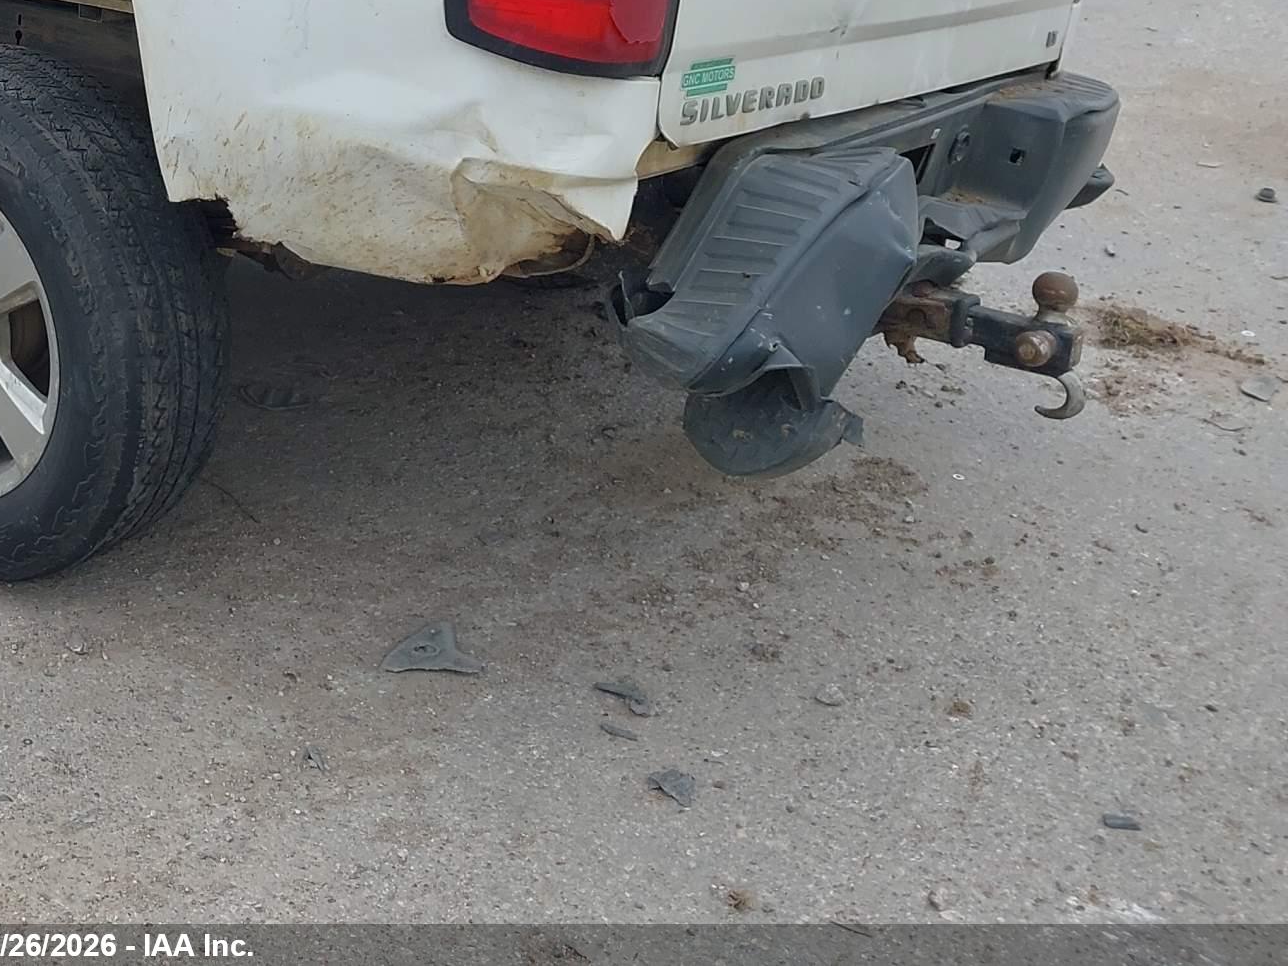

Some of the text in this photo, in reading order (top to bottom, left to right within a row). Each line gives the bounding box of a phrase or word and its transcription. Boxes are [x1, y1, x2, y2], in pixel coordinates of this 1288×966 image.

[683, 67, 735, 87] GNC MOTORS
[680, 76, 825, 126] SILVERADO
